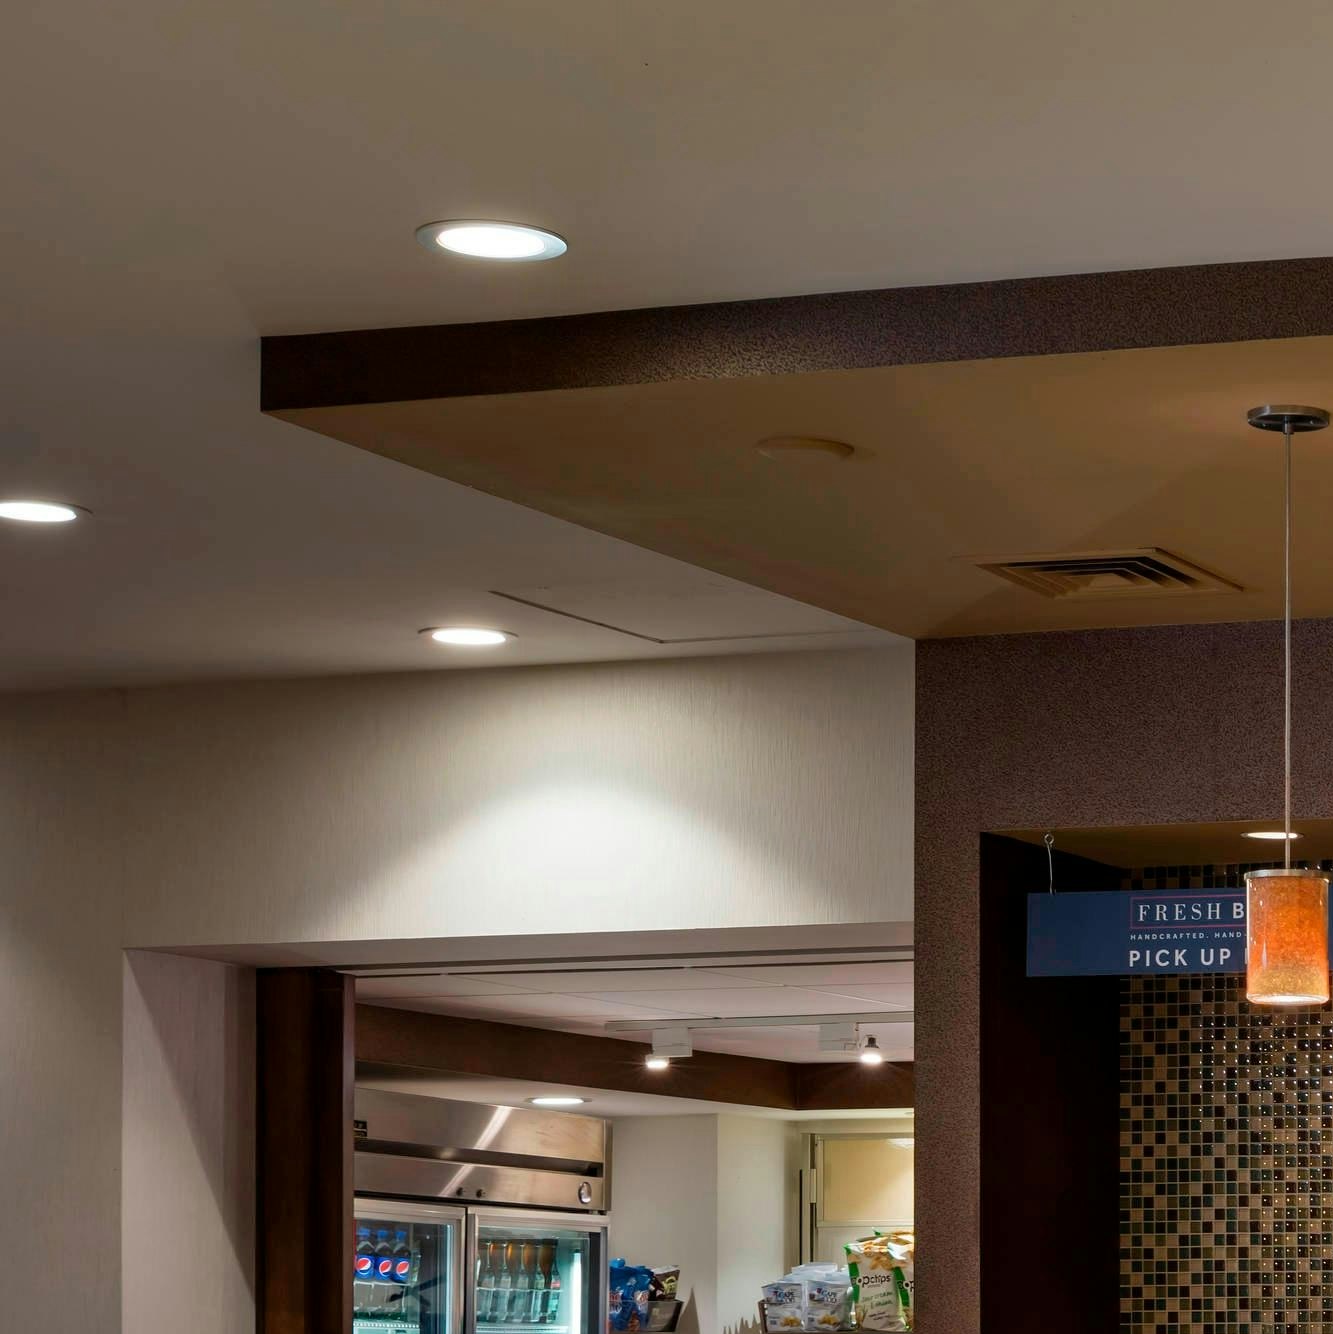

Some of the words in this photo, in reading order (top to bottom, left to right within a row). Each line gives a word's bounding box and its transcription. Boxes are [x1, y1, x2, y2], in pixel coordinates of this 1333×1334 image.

[1138, 903, 1221, 921] FRESH
[1130, 932, 1209, 940] HANDCRAFTED.
[1129, 949, 1188, 967] PICK
[1200, 948, 1231, 966] UP
